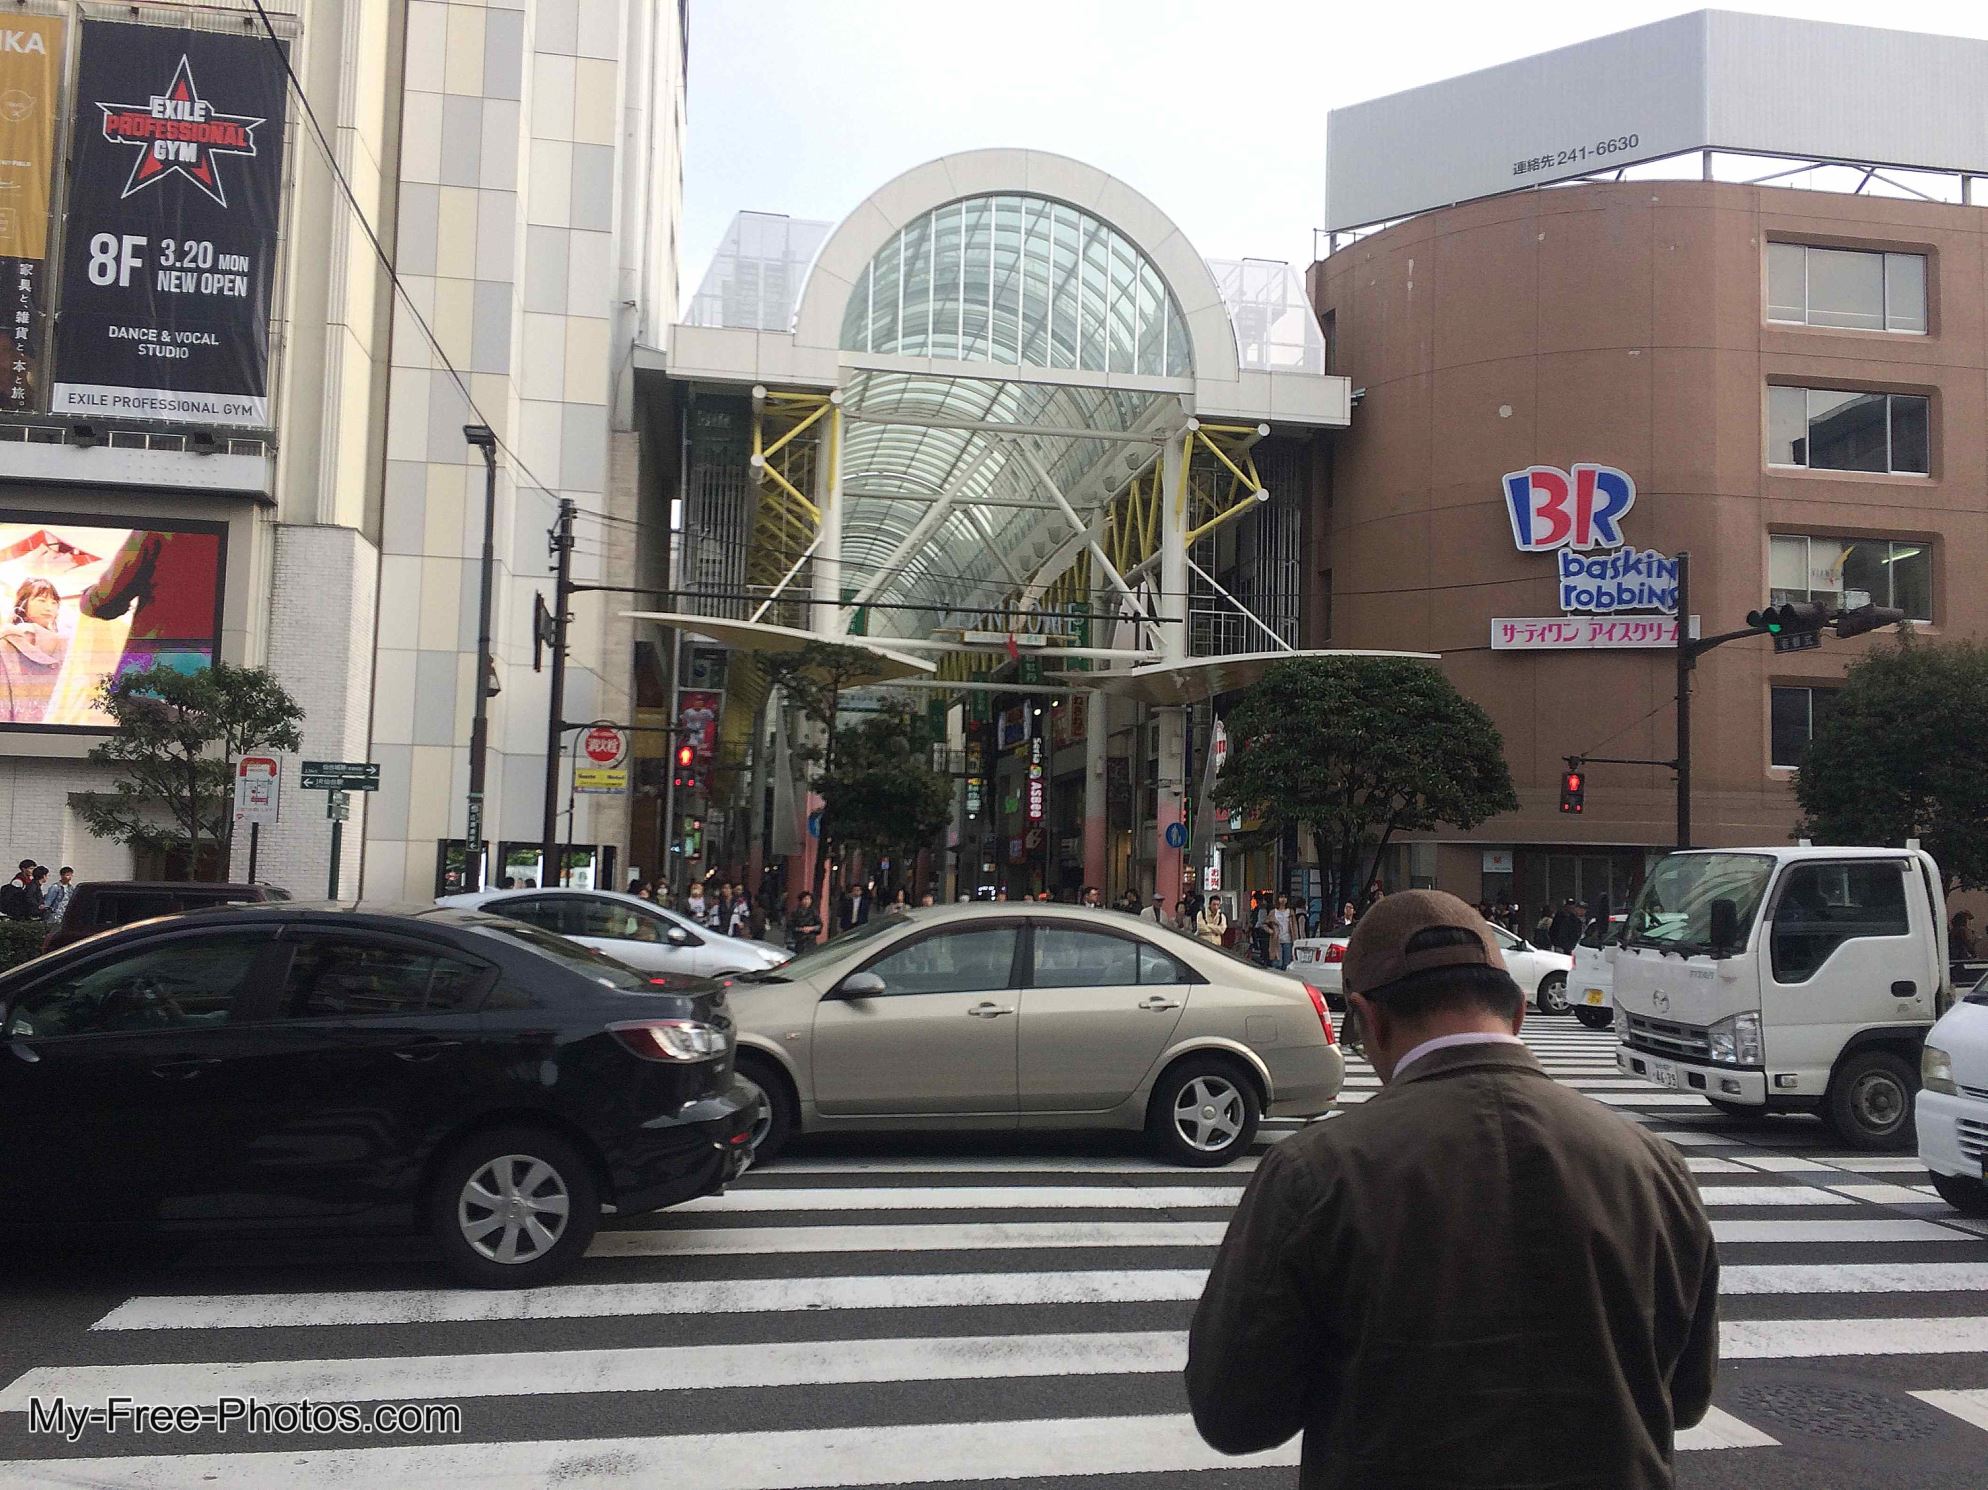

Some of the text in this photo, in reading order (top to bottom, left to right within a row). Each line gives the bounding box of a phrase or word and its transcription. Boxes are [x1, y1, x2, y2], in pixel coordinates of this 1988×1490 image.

[0, 30, 46, 55] KA
[151, 98, 206, 123] EXILE
[106, 112, 248, 147] PROFESSIONAL
[153, 140, 198, 163] GYM
[1513, 133, 1640, 175] 連絡先 241-6630
[88, 232, 148, 288] 8F
[160, 238, 250, 272] 3.20 MON
[157, 270, 248, 297] NEW OPEN
[11, 263, 34, 406] 家具と、雑貨と、本と旅。
[108, 325, 221, 345] DANCE & VOCAL
[138, 343, 190, 359] STUDIO
[68, 392, 253, 416] EXILE PROFESSIONAL GYM
[1507, 468, 1631, 547] BR
[1502, 623, 1580, 643] サーティワン
